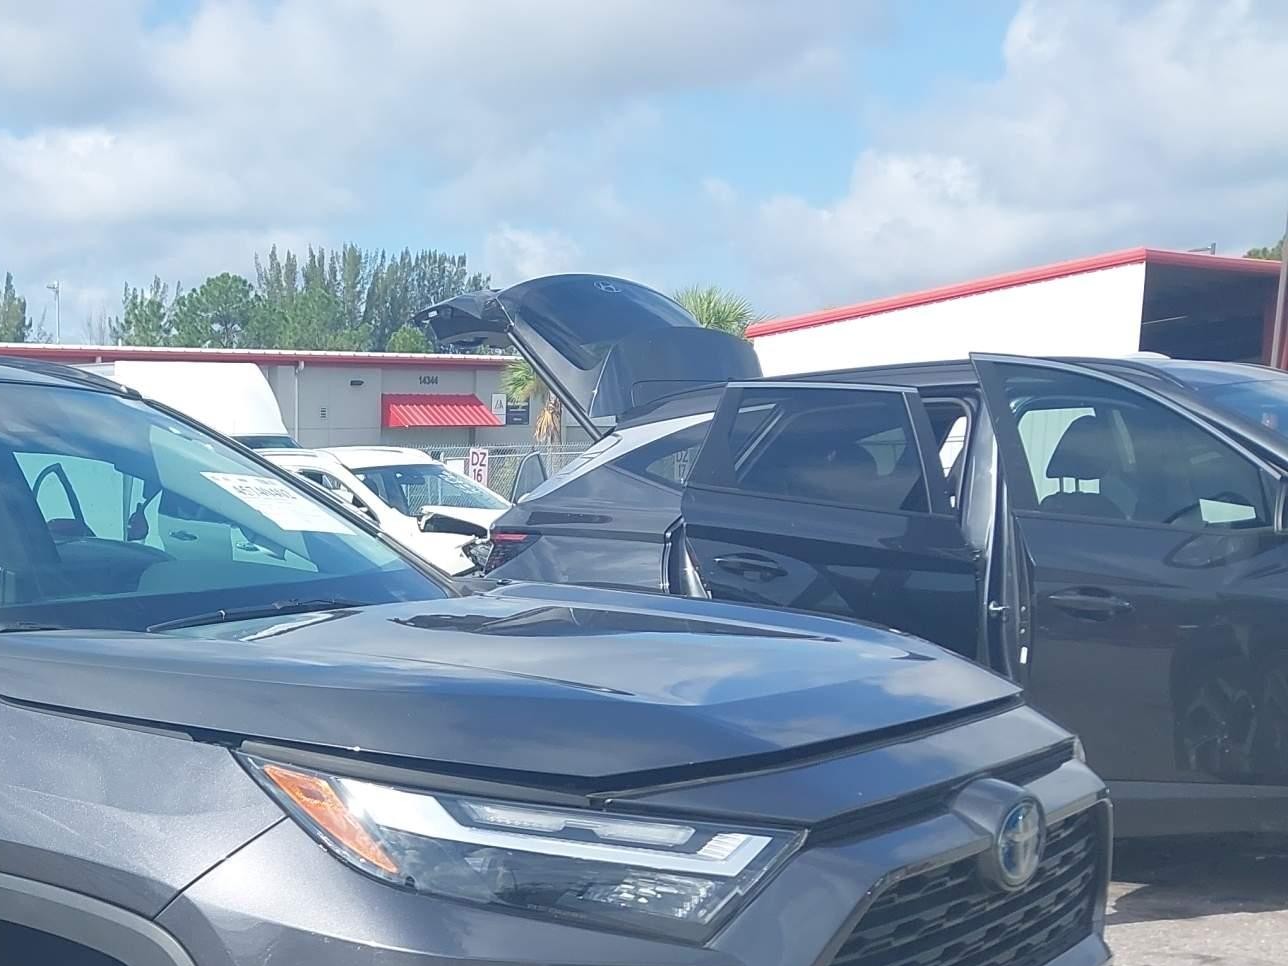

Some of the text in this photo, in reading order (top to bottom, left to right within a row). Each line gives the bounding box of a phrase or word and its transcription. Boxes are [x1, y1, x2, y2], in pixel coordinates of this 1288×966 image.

[418, 375, 439, 385] 14344
[471, 451, 487, 467] DZ
[472, 468, 483, 483] 16
